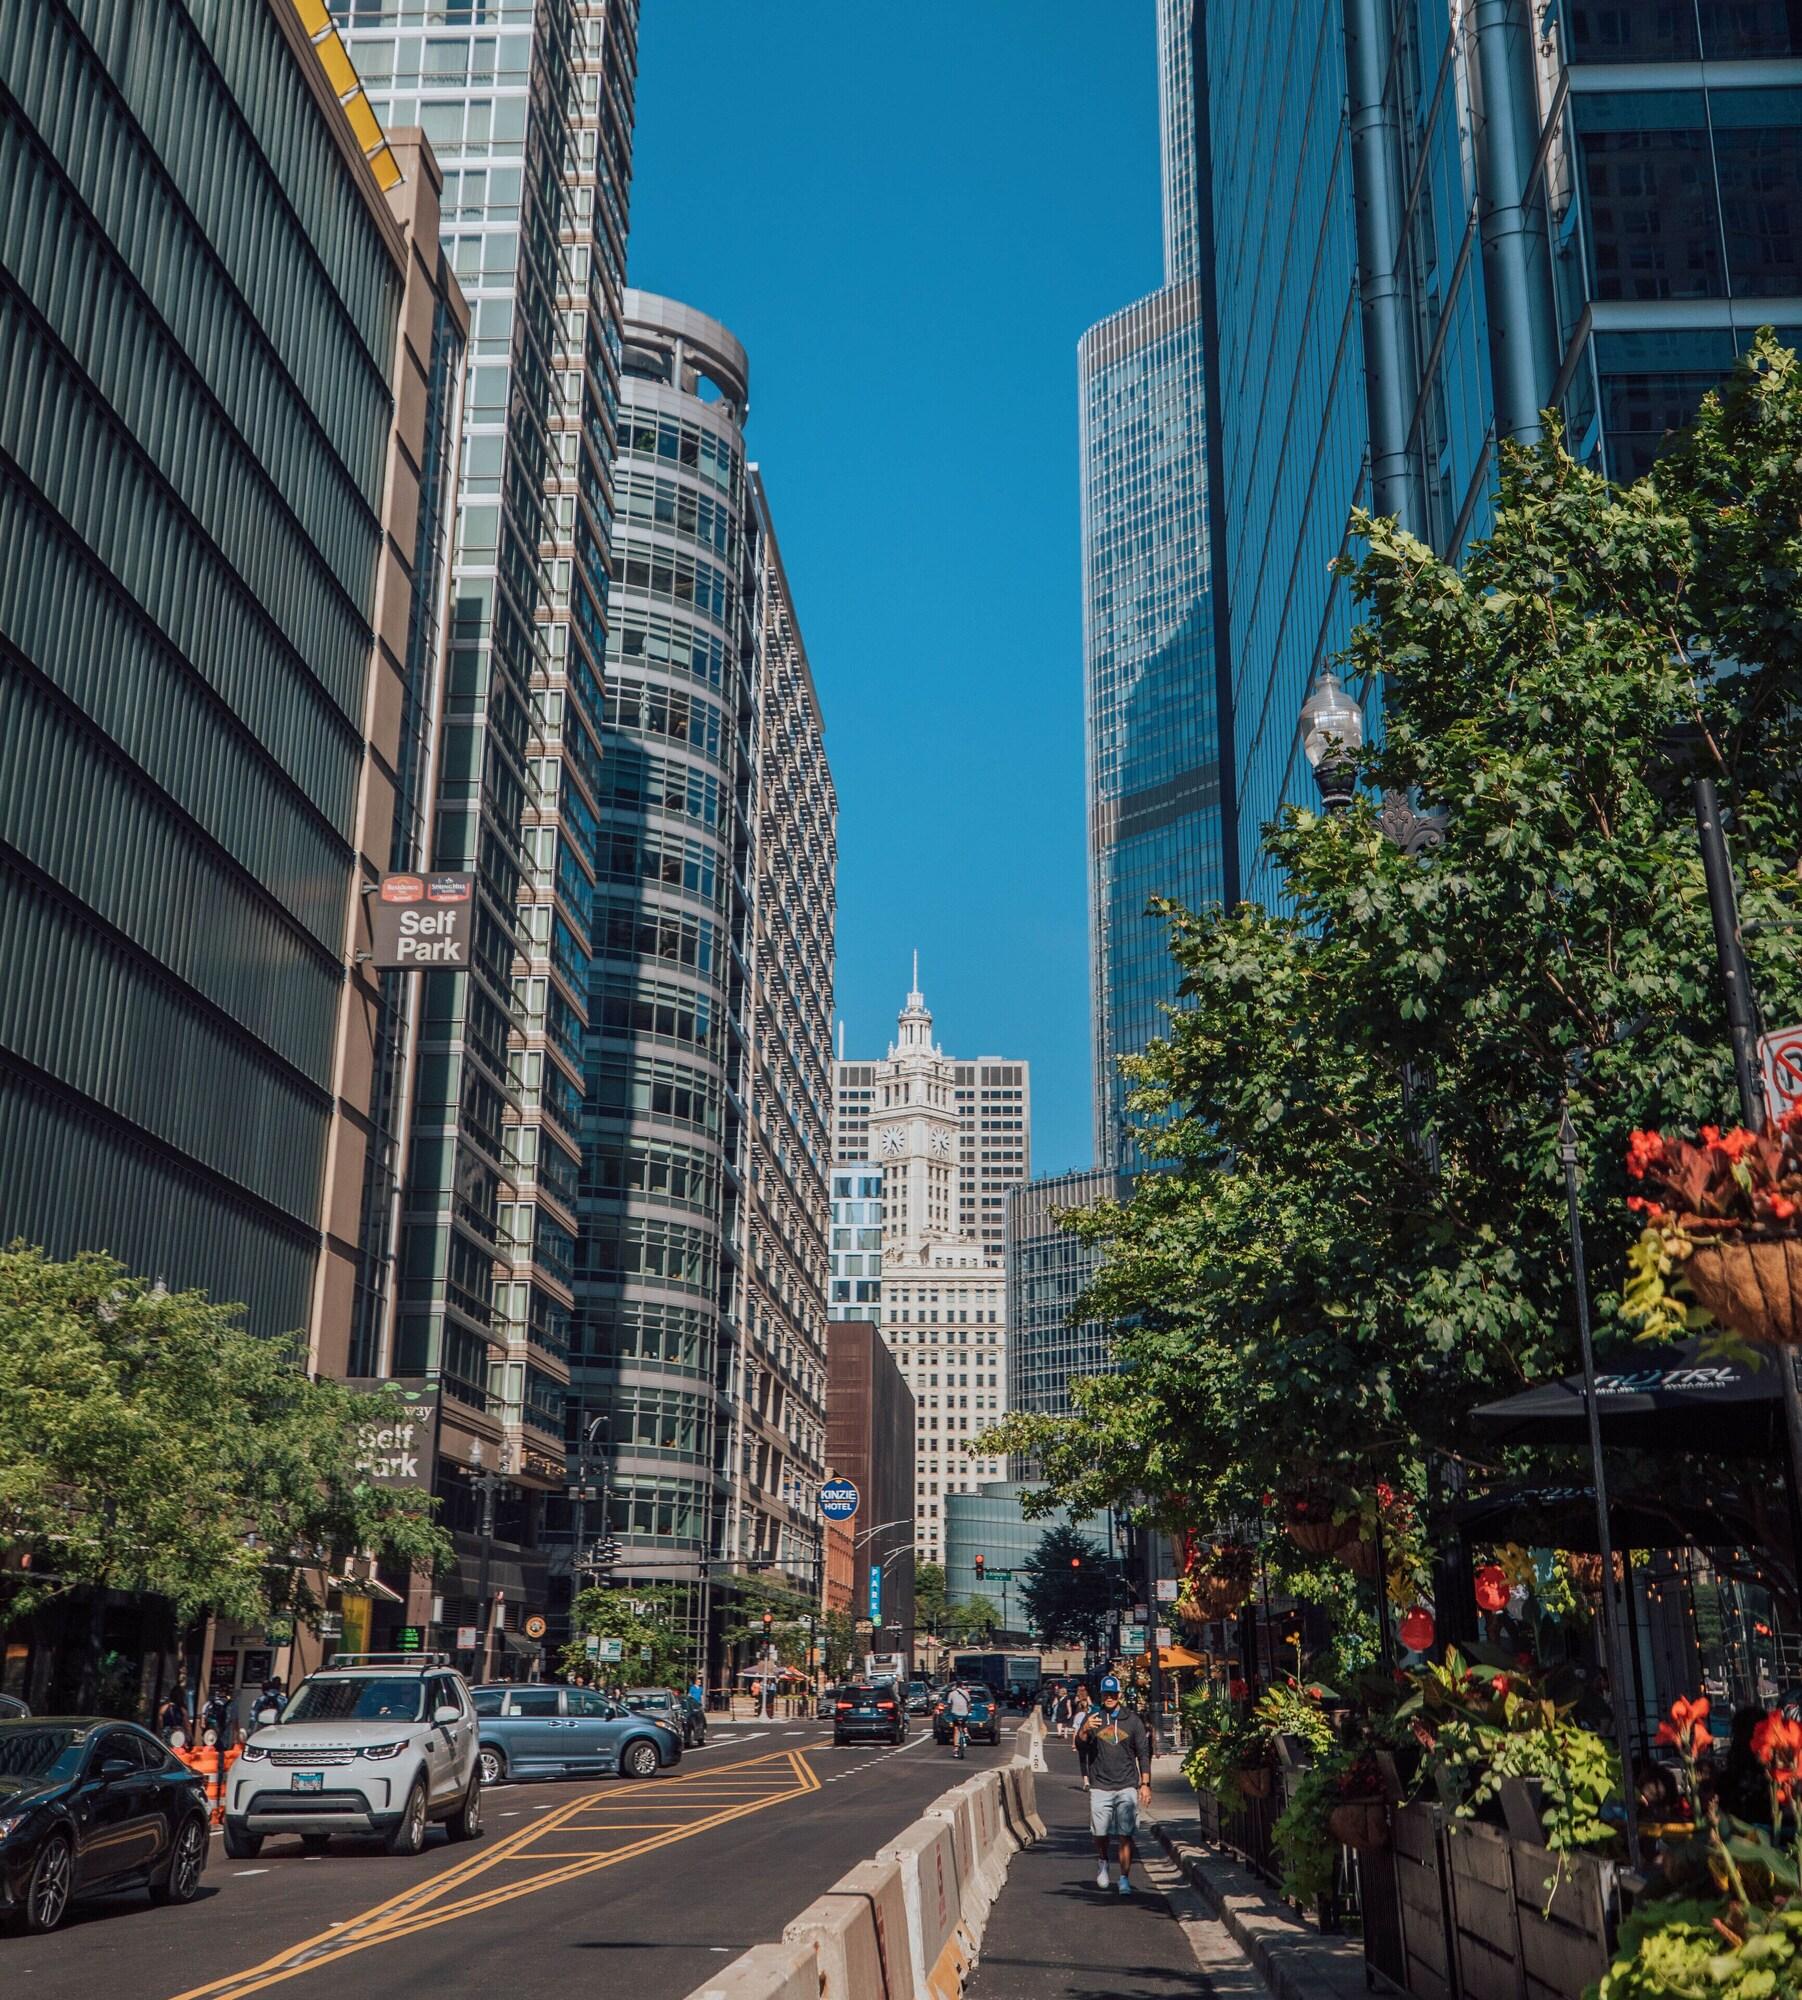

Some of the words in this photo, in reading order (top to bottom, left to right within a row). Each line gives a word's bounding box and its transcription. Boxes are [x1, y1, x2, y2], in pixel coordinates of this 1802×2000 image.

[400, 911, 456, 935] Self
[397, 938, 461, 961] Park
[820, 1489, 857, 1500] KINZIE
